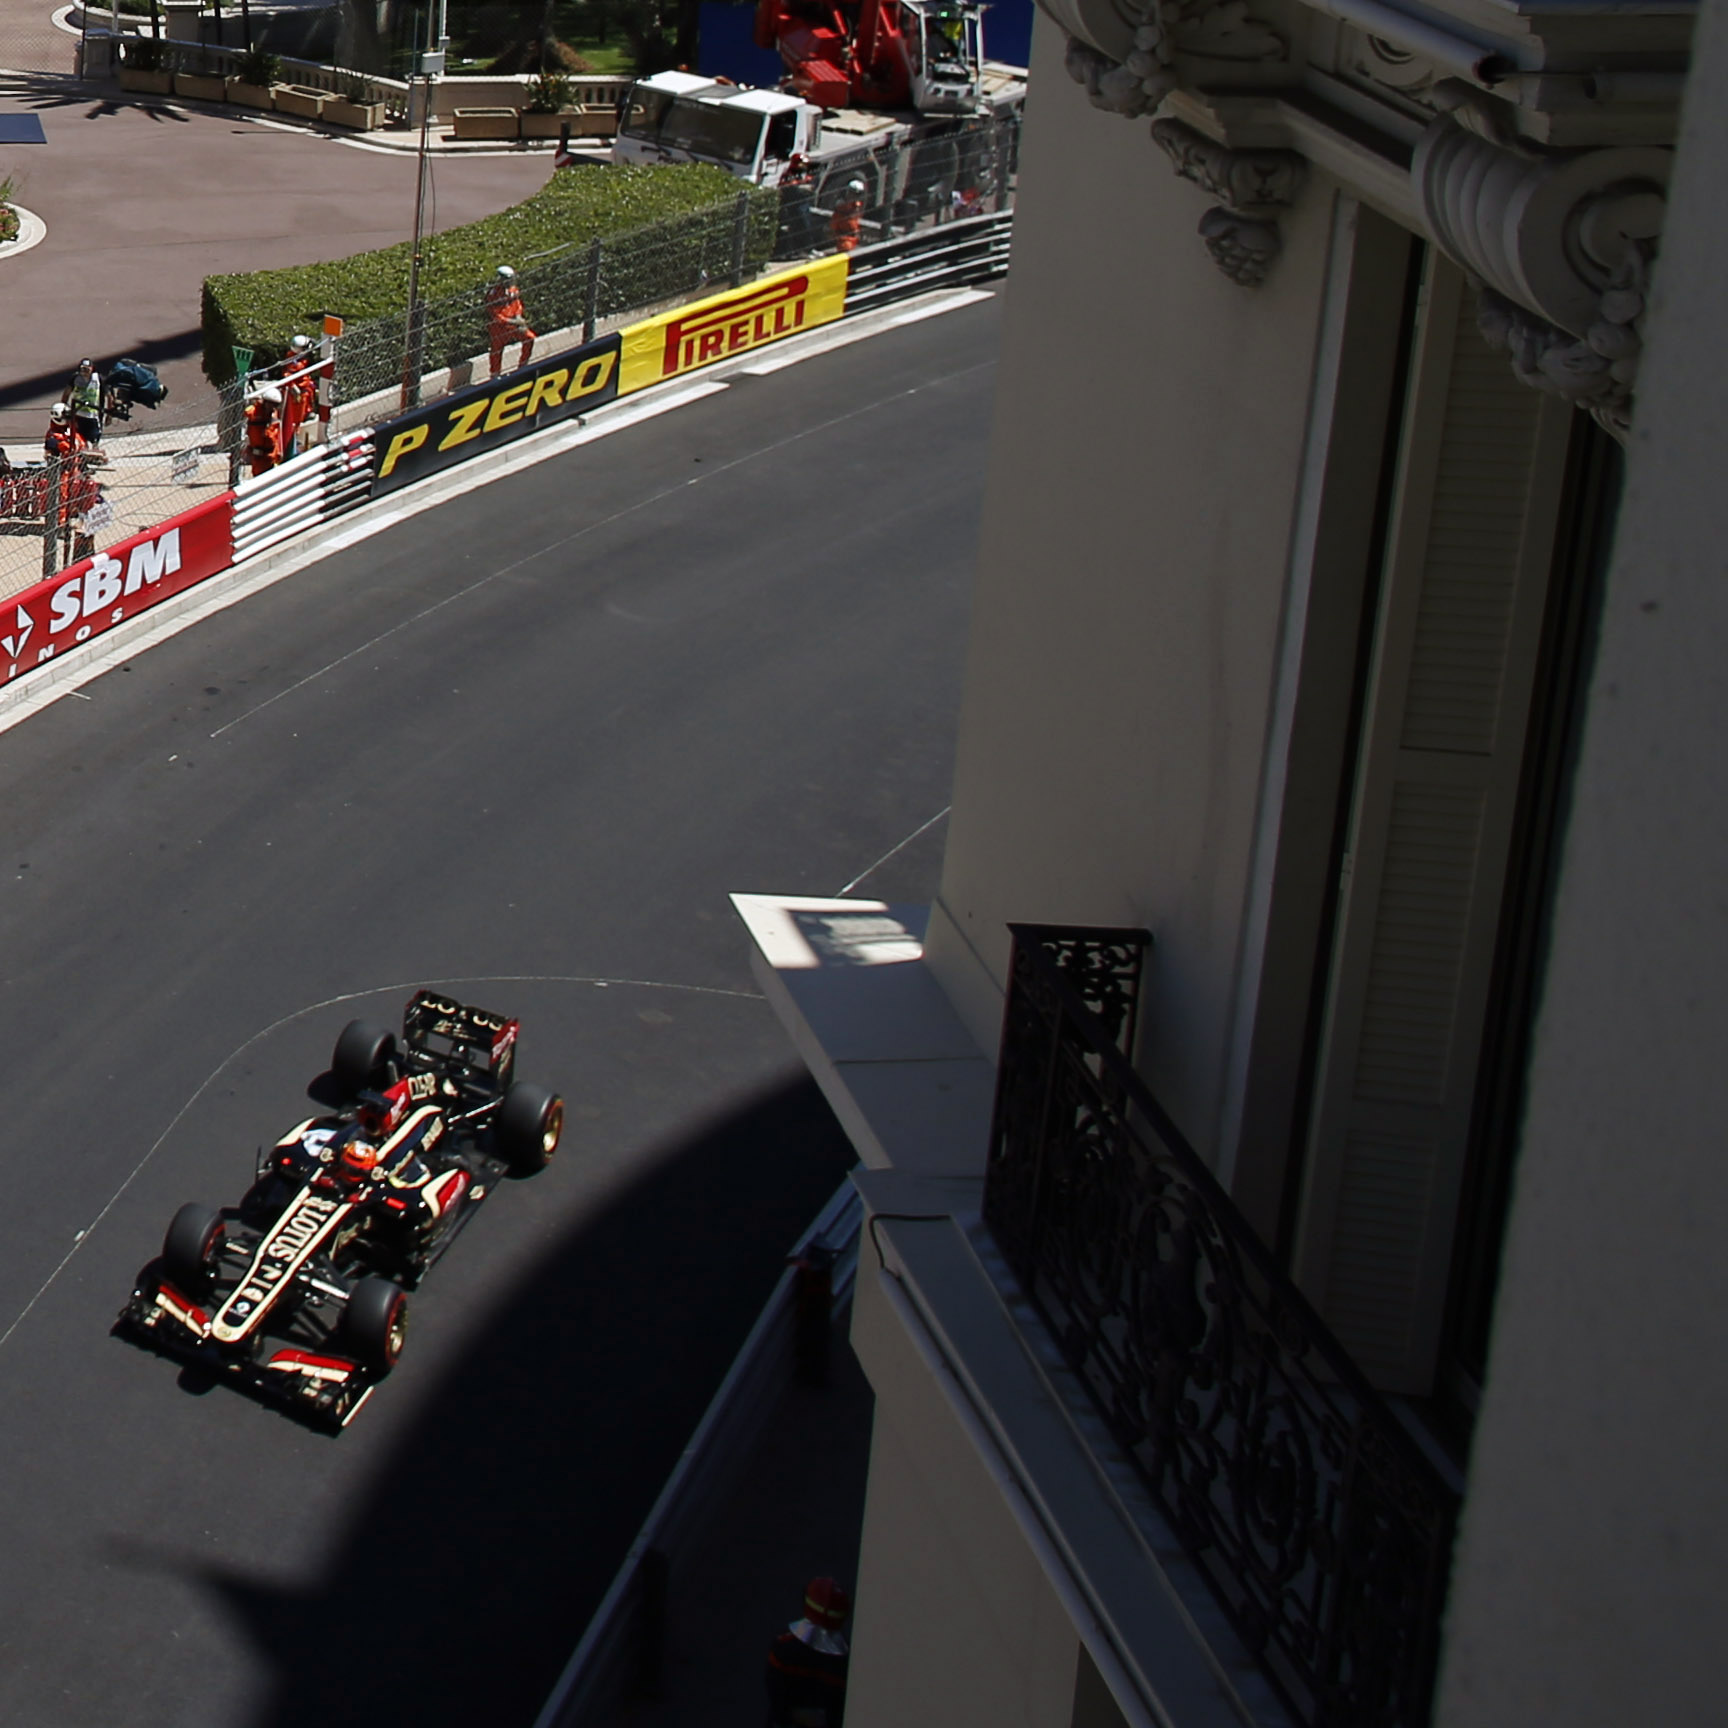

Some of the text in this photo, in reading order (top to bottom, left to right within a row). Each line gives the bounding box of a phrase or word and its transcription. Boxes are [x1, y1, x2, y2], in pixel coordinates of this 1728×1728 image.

[662, 275, 809, 377] PIRELLI
[378, 350, 618, 479] P ZERO
[49, 526, 182, 635] SBM
[268, 1206, 328, 1263] LOTUS
